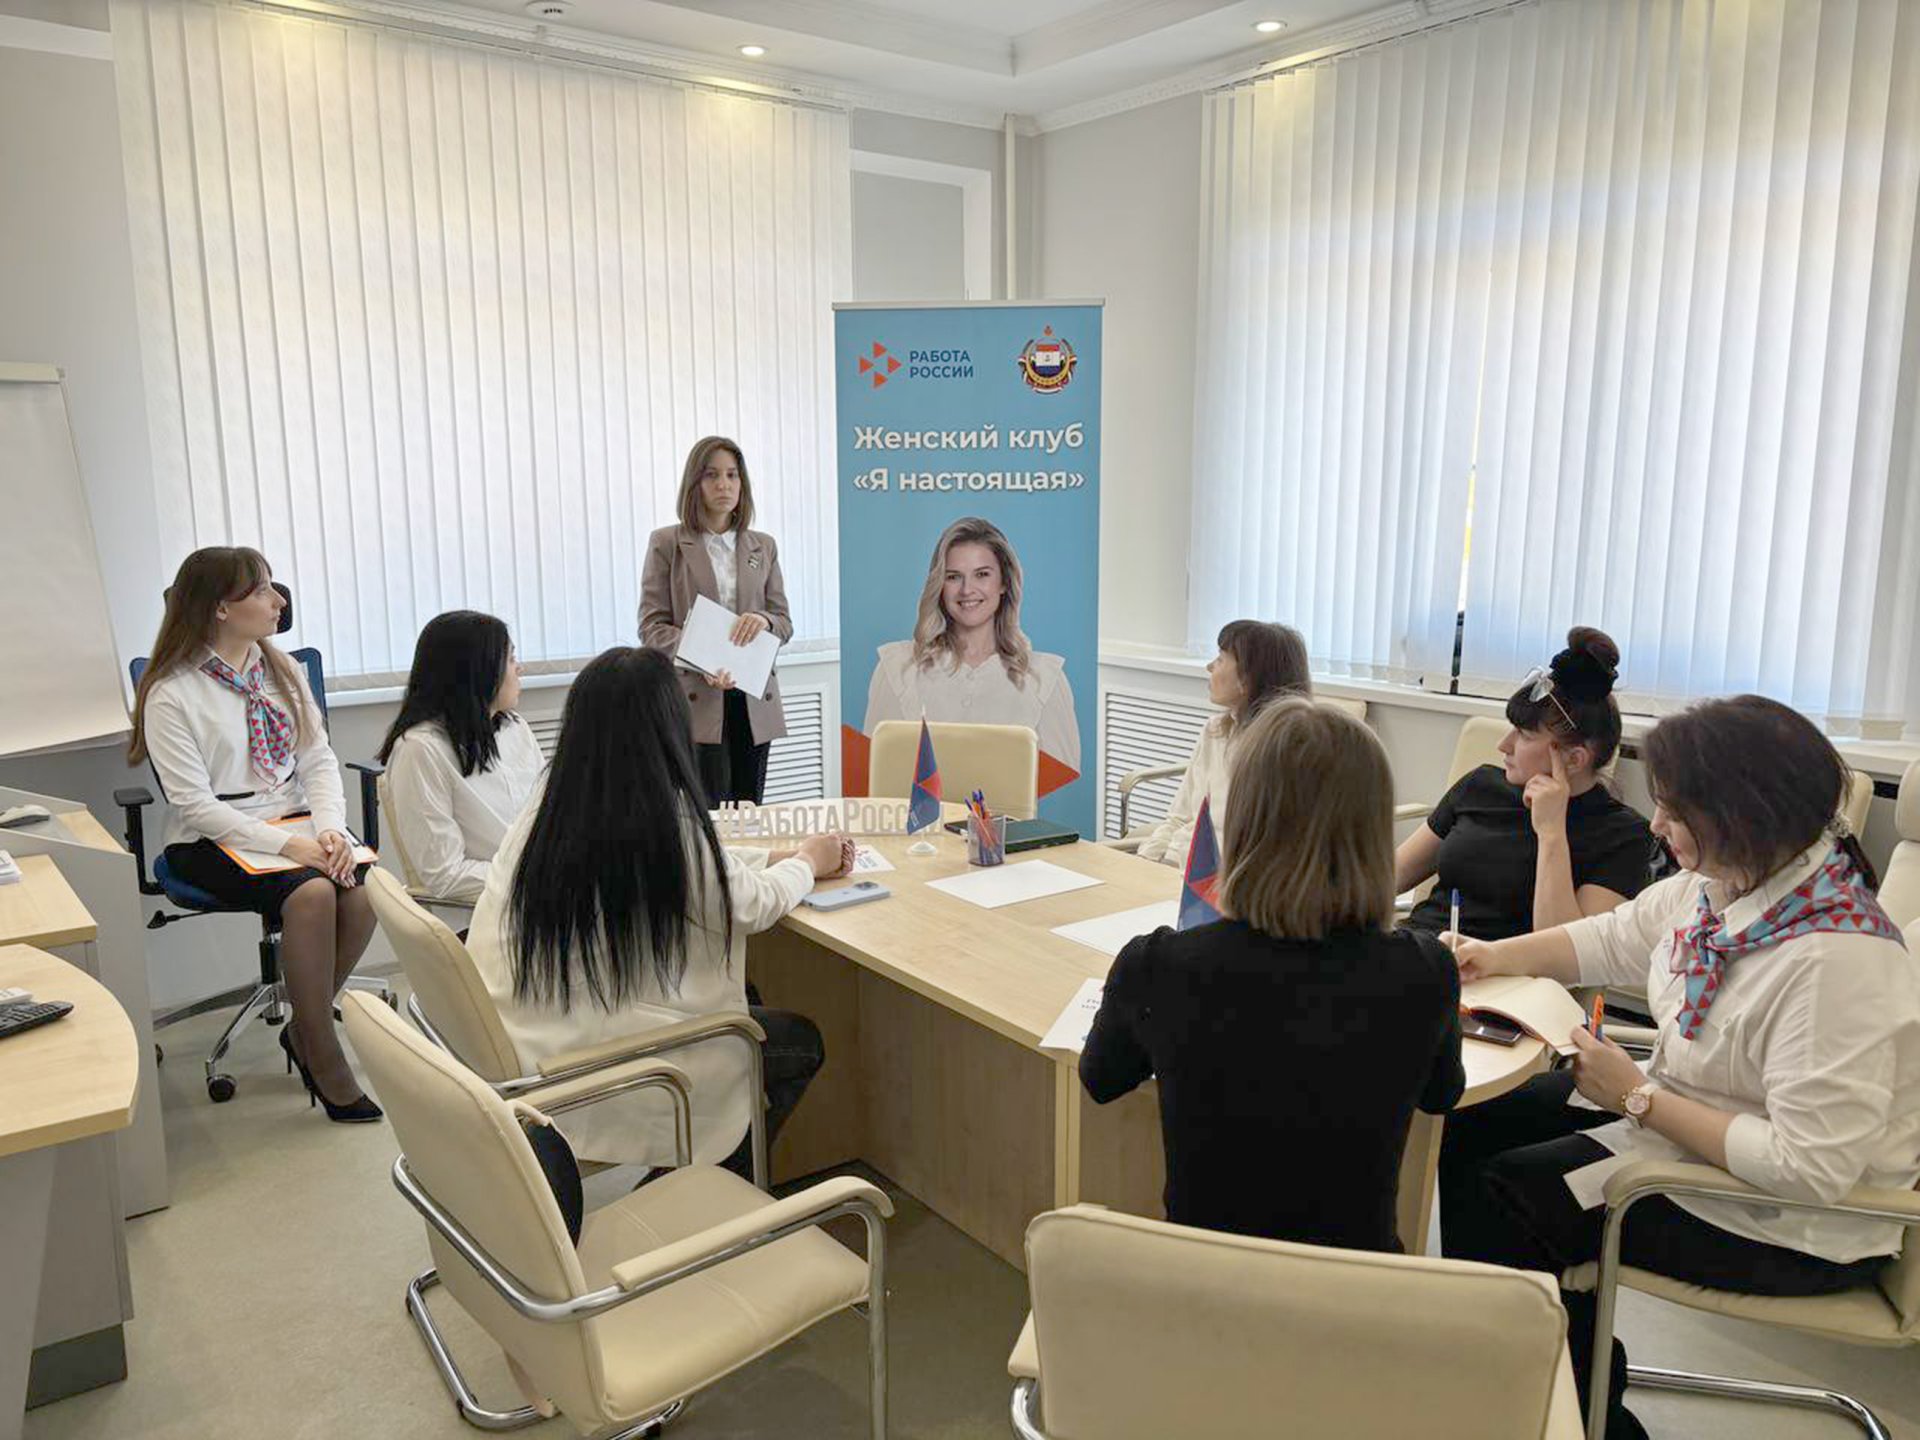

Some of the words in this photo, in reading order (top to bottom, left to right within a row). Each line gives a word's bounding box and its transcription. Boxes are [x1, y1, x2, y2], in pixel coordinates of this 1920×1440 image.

[909, 350, 971, 363] РАБОТА
[909, 365, 974, 379] РОССИИ
[854, 424, 999, 450] Женский
[1008, 422, 1085, 454] клуб
[853, 468, 889, 491] «Я
[899, 470, 1085, 493] настоящая»
